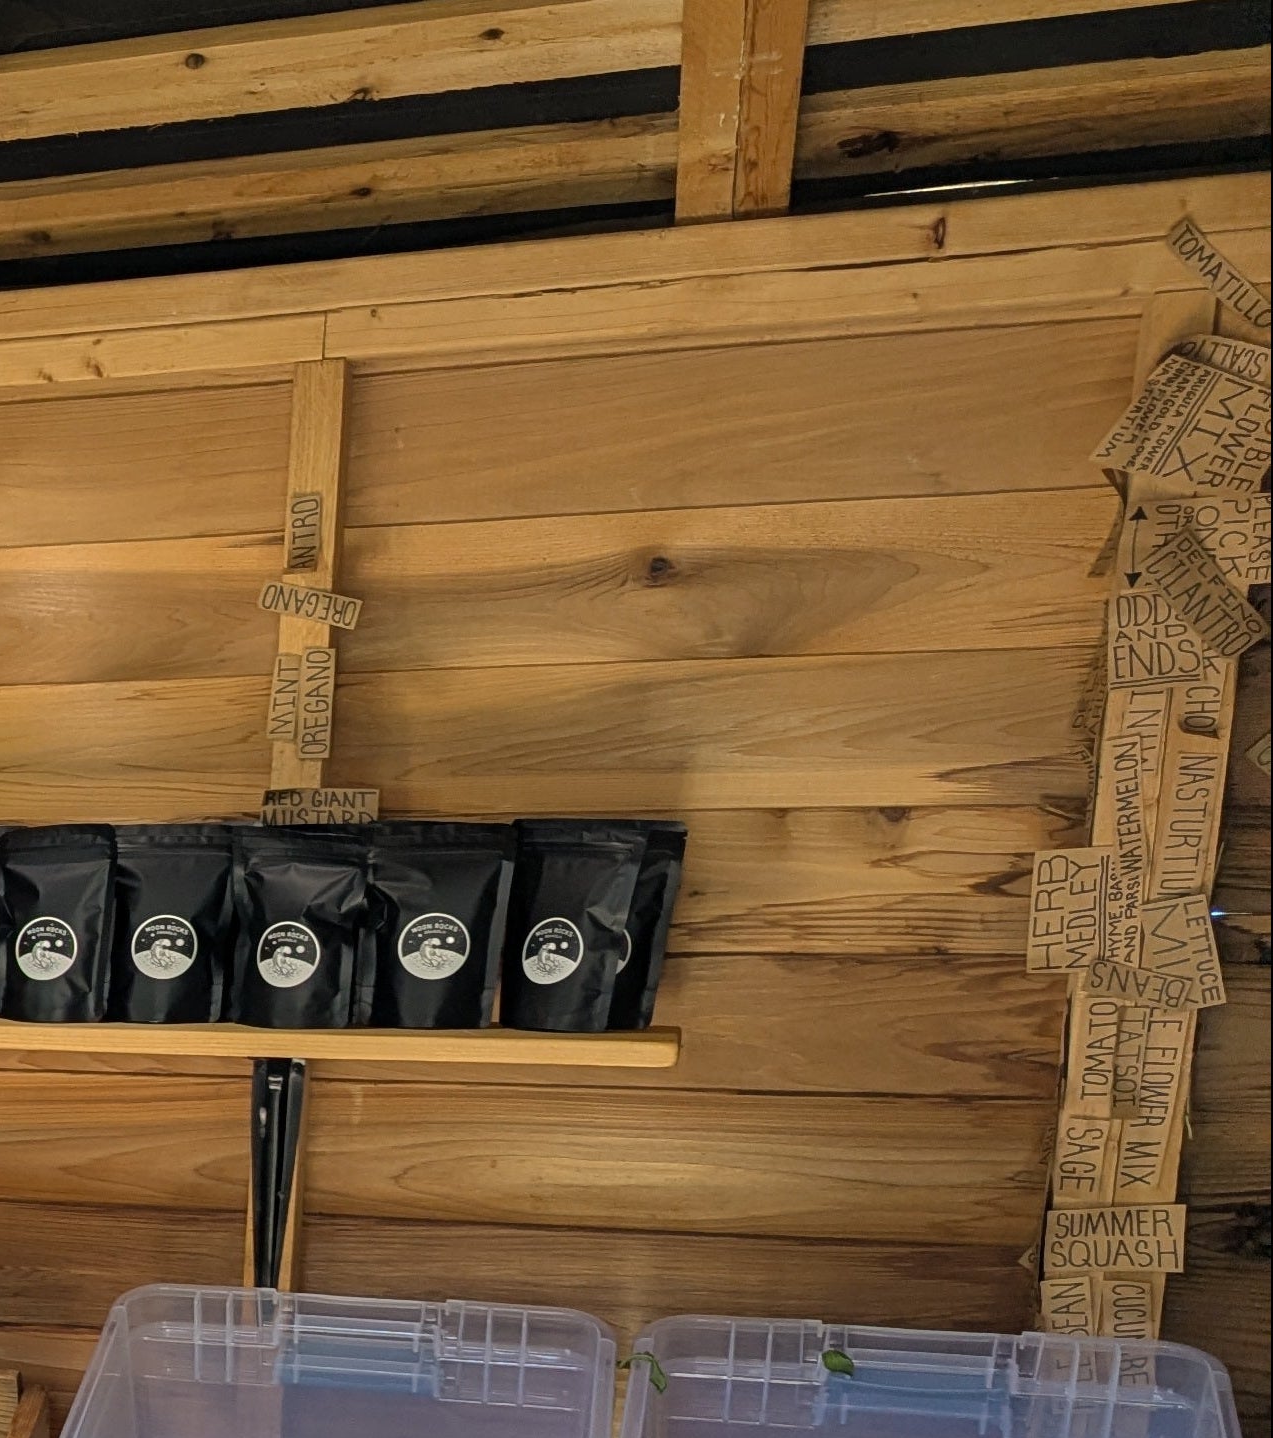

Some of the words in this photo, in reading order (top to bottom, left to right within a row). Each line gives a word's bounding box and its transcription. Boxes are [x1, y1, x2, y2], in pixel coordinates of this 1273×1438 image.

[1162, 377, 1254, 482] MIX
[1219, 499, 1252, 578] PICK
[261, 584, 357, 627] OREGANO
[1146, 551, 1252, 658] CILANTRO
[1177, 537, 1262, 634] DELFINO
[1113, 640, 1201, 679] ENDS
[1115, 624, 1187, 643] AND
[270, 658, 298, 735] MINT
[300, 649, 331, 755] OREGANO
[262, 791, 301, 807] RED
[312, 790, 377, 808] GIANT
[1031, 855, 1068, 972] HERB
[1065, 859, 1100, 968] MEDLEY
[1124, 925, 1138, 964] AND
[1182, 899, 1221, 1004] LETTUCE
[1090, 962, 1185, 1009] BEANS
[1059, 1126, 1103, 1192] SAGE
[1119, 1140, 1161, 1188] MIX
[1051, 1239, 1180, 1269] SQUASH
[1055, 1209, 1174, 1240] SUMMER
